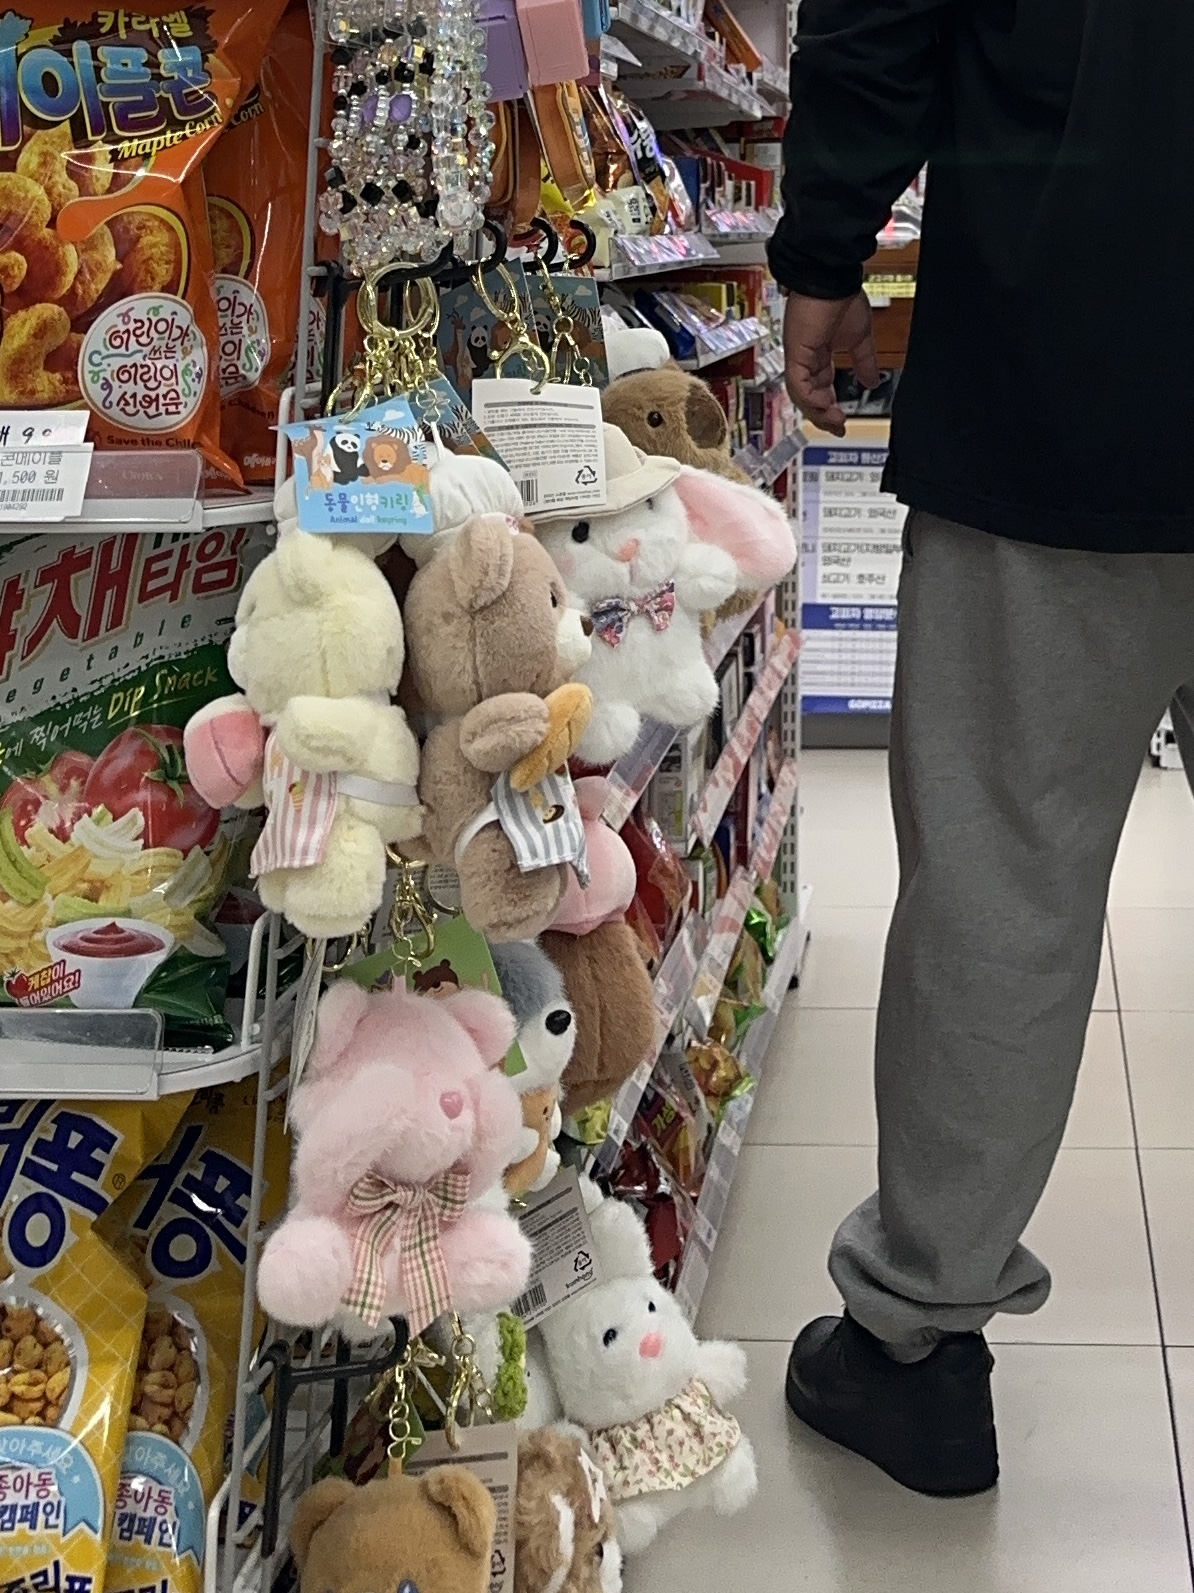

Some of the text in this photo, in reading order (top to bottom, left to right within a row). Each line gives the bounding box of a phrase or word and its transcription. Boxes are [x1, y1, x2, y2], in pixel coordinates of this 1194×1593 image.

[97, 8, 194, 40] 카라멜
[117, 110, 223, 161] Maple Corn
[108, 311, 192, 353] 어린이가
[116, 363, 179, 391] 어린이
[107, 435, 140, 446] Save
[141, 437, 163, 447] the
[44, 469, 59, 485] 원
[324, 492, 409, 514] 동물인형키링
[330, 515, 358, 524] Animal
[27, 960, 66, 991] 케찹이
[117, 1511, 178, 1548] 캠페인
